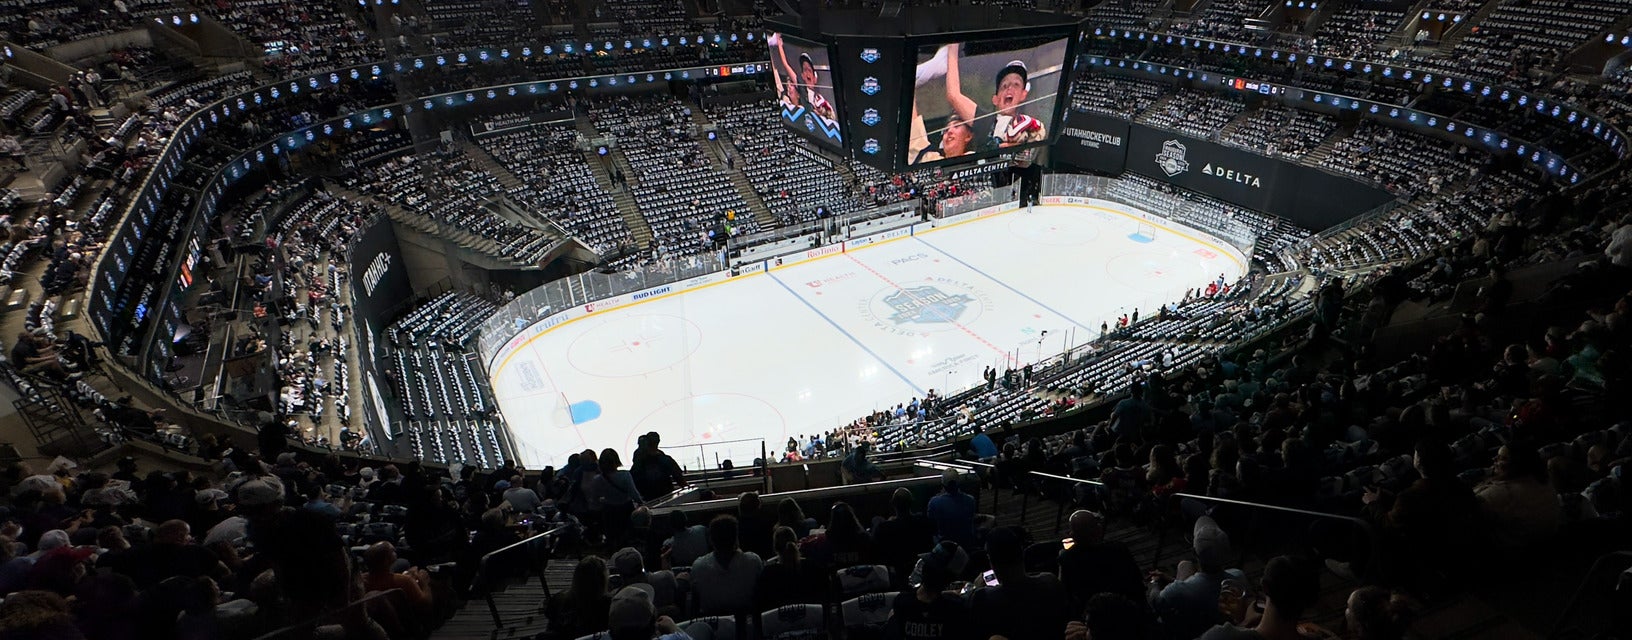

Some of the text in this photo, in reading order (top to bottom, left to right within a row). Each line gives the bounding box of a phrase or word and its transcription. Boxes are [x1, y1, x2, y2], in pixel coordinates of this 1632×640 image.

[1163, 150, 1183, 161] SEASON
[959, 162, 1008, 177] DELTA CENTER
[1216, 167, 1260, 188] DELTA
[887, 228, 908, 239] DELTA
[633, 286, 671, 300] BUD LIGHT
[895, 291, 948, 312] SEASON
[905, 621, 944, 637] COOLEY
